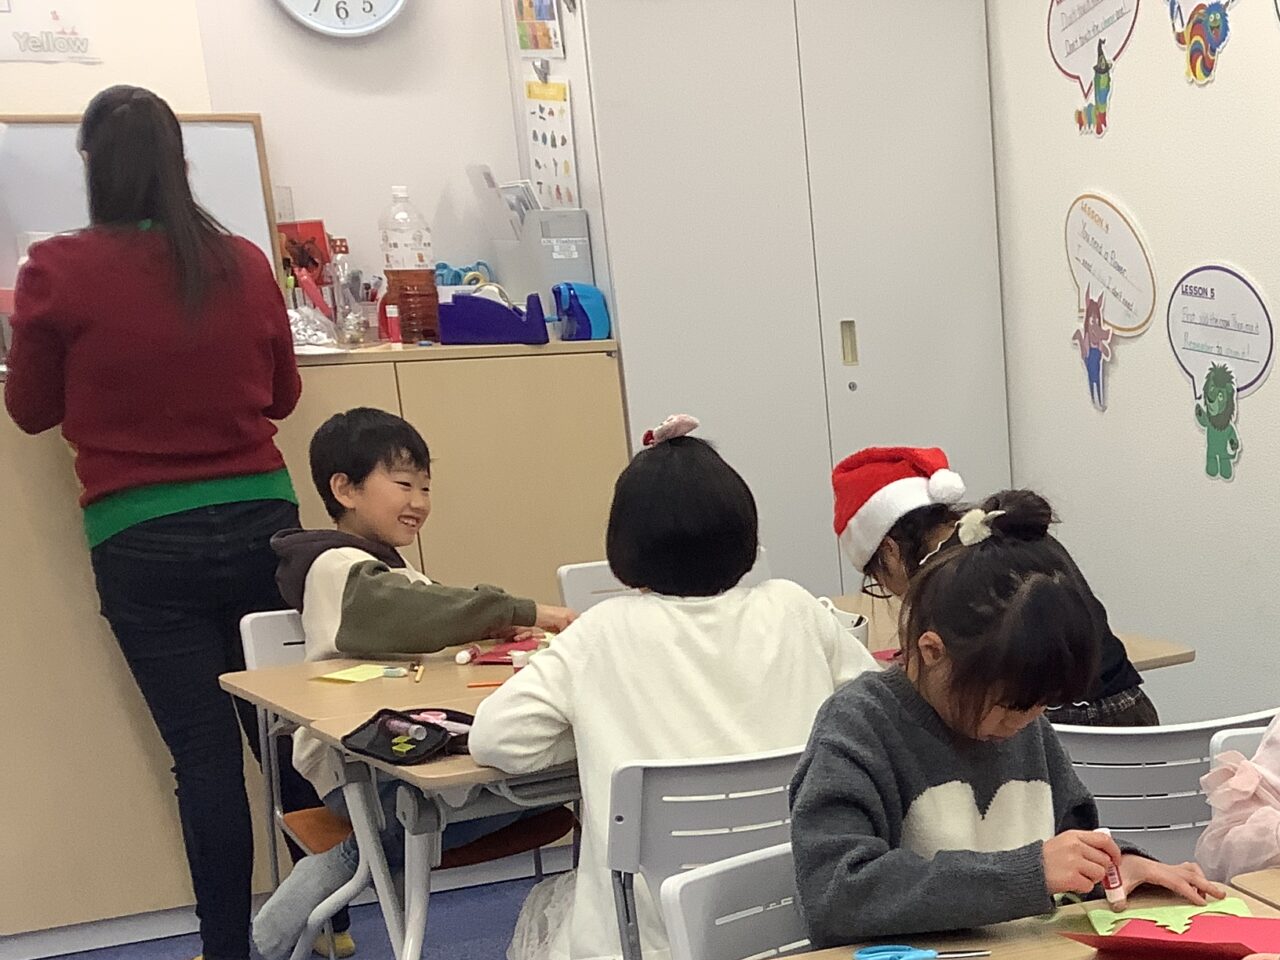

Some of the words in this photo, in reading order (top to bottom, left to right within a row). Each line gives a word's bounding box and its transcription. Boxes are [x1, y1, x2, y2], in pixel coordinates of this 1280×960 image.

[335, 0, 349, 20] 6
[362, 0, 373, 13] 5
[12, 30, 89, 53] Yellow
[1181, 284, 1209, 297] LESSON
[1210, 288, 1216, 298] 5
